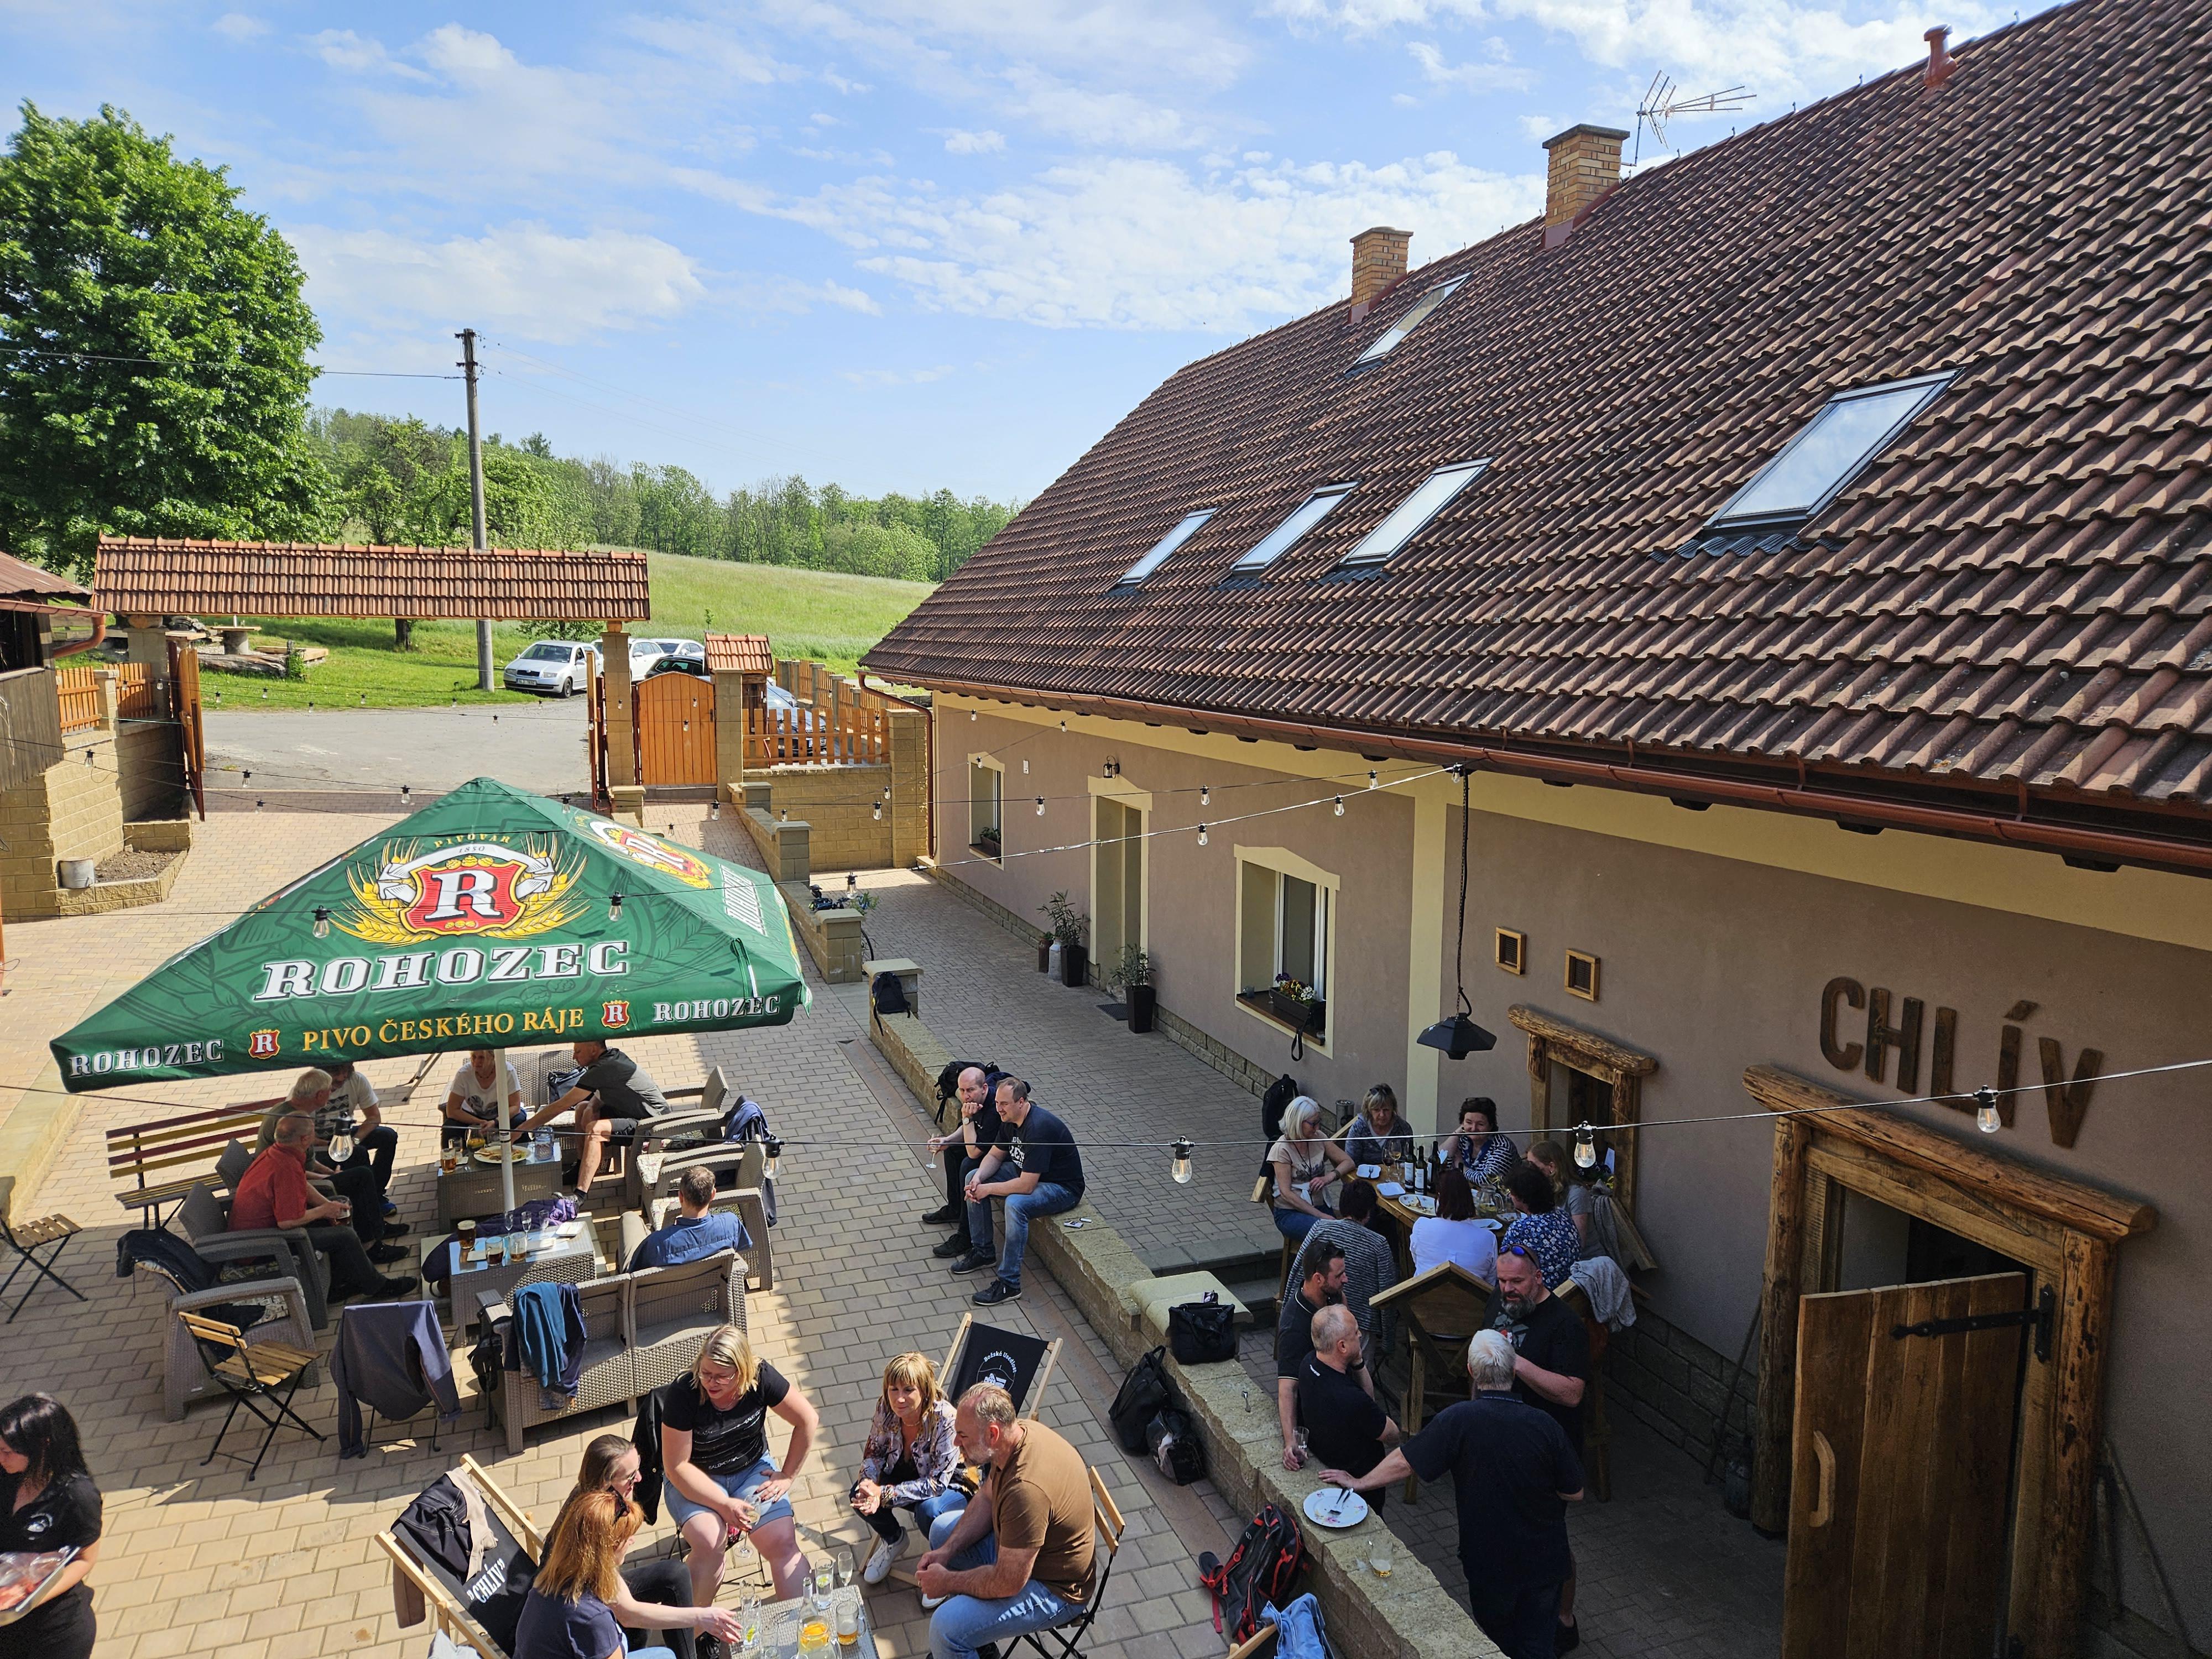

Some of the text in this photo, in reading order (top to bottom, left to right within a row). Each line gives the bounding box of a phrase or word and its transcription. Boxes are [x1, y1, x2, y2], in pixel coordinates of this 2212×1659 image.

[434, 834, 511, 848] PIVOVAR
[424, 869, 504, 922] R
[254, 941, 627, 1001] ROHOZEC
[606, 1004, 625, 1023] R
[653, 995, 780, 1023] ROHOZEC
[254, 1034, 274, 1053] R
[302, 1007, 585, 1051] PIVO ČESKÉHO RÁJE
[69, 1039, 223, 1078] ROHOZEC
[1819, 976, 2104, 1149] CHLÍV
